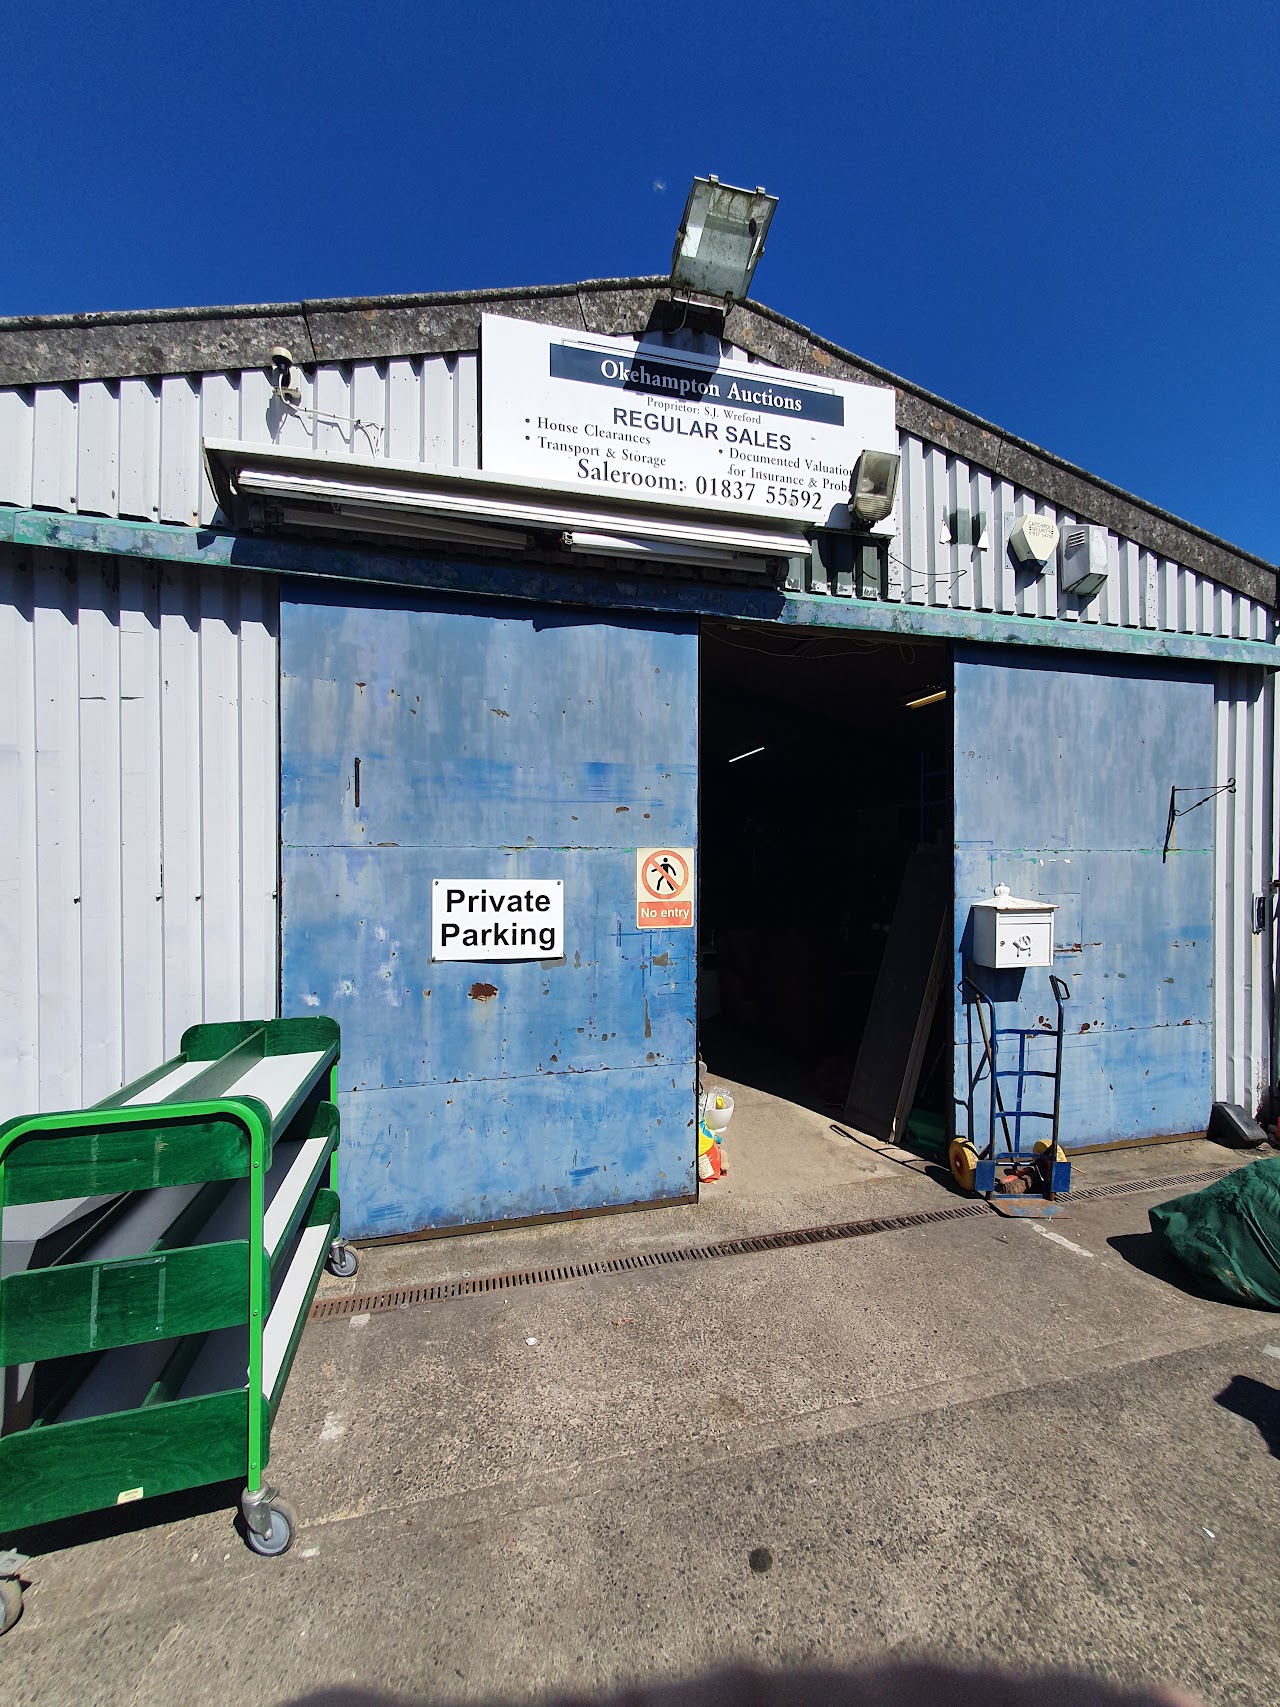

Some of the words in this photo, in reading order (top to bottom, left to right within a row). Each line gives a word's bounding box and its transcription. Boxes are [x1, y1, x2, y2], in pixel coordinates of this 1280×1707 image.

[600, 359, 720, 397] Okehampton
[727, 382, 802, 412] Auctions
[647, 396, 700, 415] Proprietor:
[704, 407, 719, 419] S.J.
[723, 409, 762, 425] Wreford
[537, 416, 579, 434] House
[584, 423, 651, 446] Clearances
[613, 407, 719, 441] REGULAR
[725, 426, 792, 452] SALES
[538, 436, 601, 457] Transport
[606, 448, 616, 459] &
[622, 449, 667, 468] Storage
[729, 447, 800, 469] Documented
[577, 458, 684, 492] Saleroom:
[695, 475, 756, 501] 01837
[766, 485, 823, 510] 55592
[728, 464, 745, 478] for
[751, 467, 804, 486] Insurance
[808, 478, 818, 489] &
[823, 478, 850, 492] Prob
[446, 889, 551, 913] Private
[641, 907, 658, 918] No
[660, 907, 690, 920] entry
[441, 922, 556, 951] Parking
